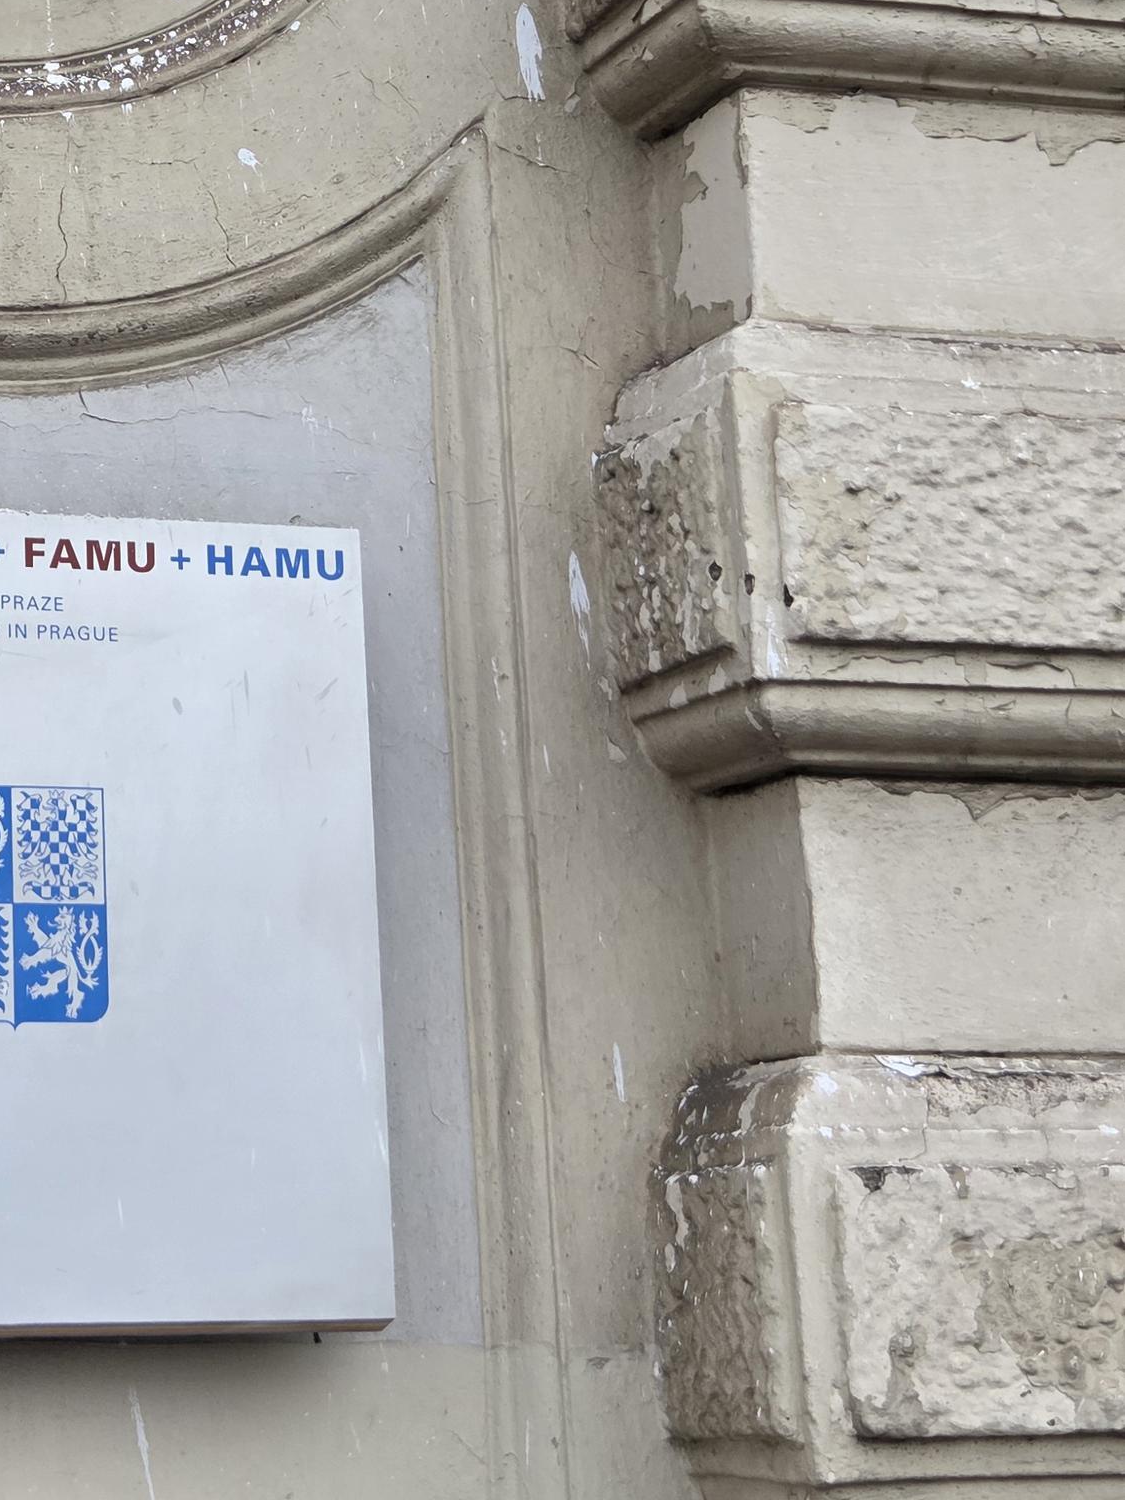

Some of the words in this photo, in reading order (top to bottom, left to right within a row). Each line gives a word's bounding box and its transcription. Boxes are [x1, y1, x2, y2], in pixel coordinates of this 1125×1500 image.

[24, 537, 156, 573] FAMU
[170, 548, 191, 570] +
[206, 544, 345, 581] HAMU
[0, 595, 65, 612] PRAZE
[8, 624, 27, 639] IN
[37, 625, 119, 642] PRAGUE
